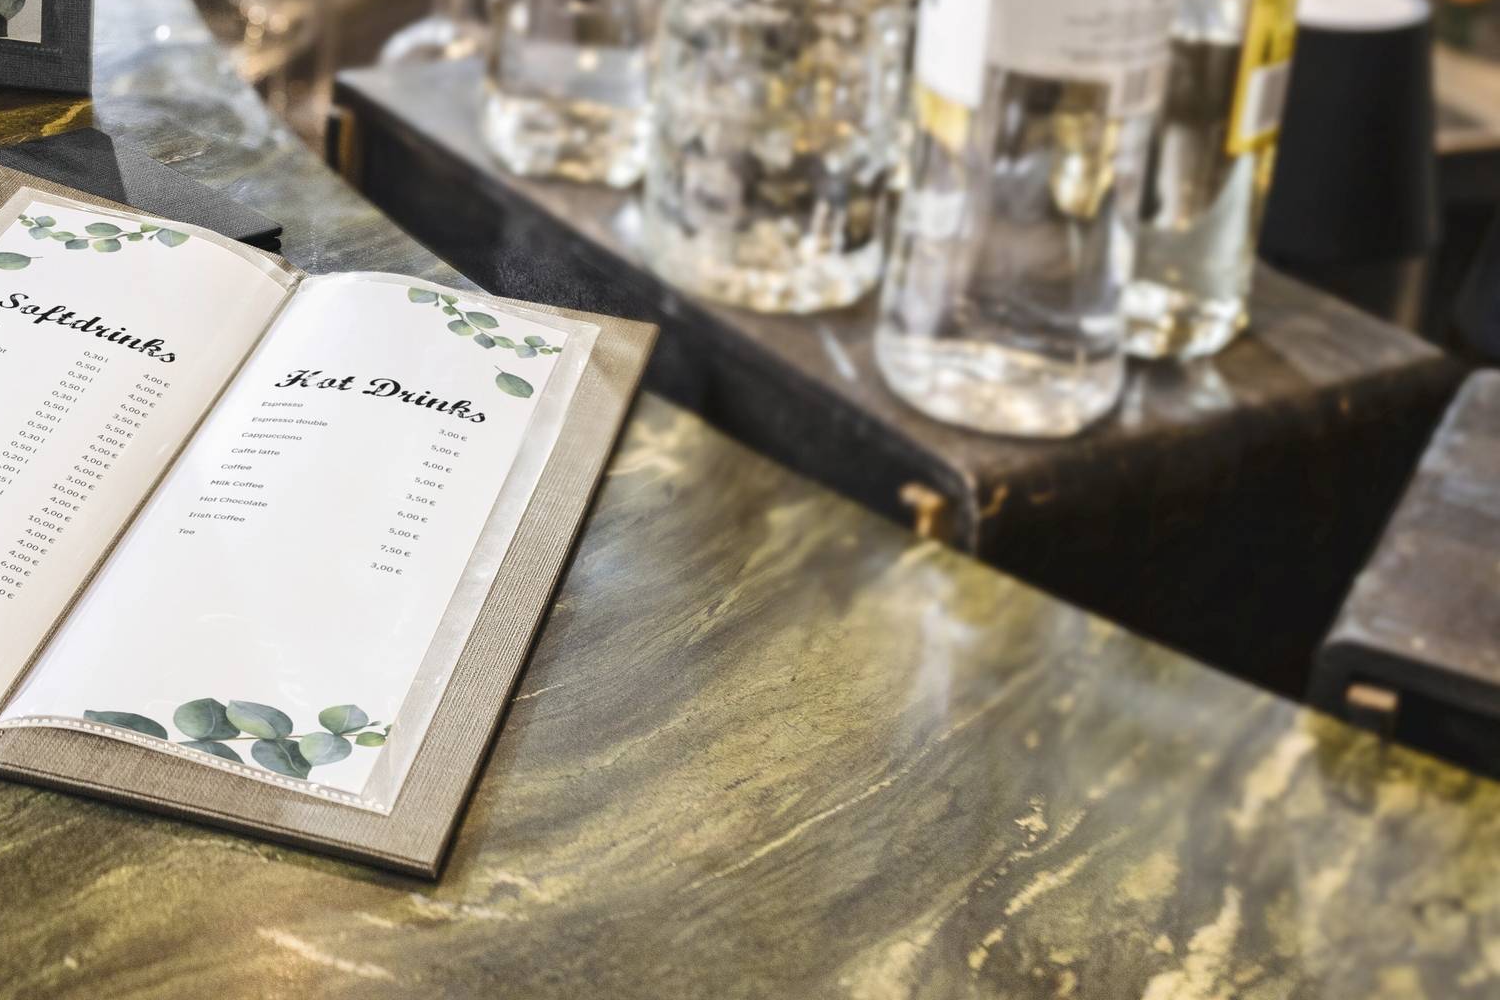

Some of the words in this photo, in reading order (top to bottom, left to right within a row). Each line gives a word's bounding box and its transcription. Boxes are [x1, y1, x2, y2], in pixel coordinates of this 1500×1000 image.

[75, 360, 97, 371] 0,50
[135, 383, 156, 395] 6,00
[83, 351, 104, 362] 0,30
[143, 374, 163, 385] 4,00
[59, 380, 81, 391] 0,50
[120, 403, 141, 415] 6,00
[67, 370, 88, 381] 0,30
[128, 393, 149, 405] 4,00
[274, 369, 356, 391] Hot
[362, 377, 486, 423] Drinks
[43, 400, 65, 411] 0,50
[105, 423, 126, 435] 5,50
[51, 390, 73, 401] 0,30
[112, 413, 134, 425] 3,50
[27, 420, 49, 432] 0,50
[89, 444, 111, 456] 6,00
[35, 410, 57, 421] 0,30
[97, 434, 118, 446] 4,00
[295, 418, 328, 427] double
[430, 444, 452, 455] 5,00
[438, 429, 460, 439] 3,00
[10, 440, 32, 452] 0,50
[73, 465, 95, 477] 6,00
[18, 430, 41, 442] 0,30
[81, 455, 103, 466] 4,00
[2, 450, 24, 462] 0,20
[66, 475, 87, 487] 3,00
[258, 448, 281, 456] latte
[414, 477, 436, 487] 5,00
[422, 461, 444, 471] 4,00
[49, 496, 72, 508] 4,00
[52, 483, 80, 498] 10,00
[232, 480, 264, 489] Coffee
[397, 510, 420, 521] 6,00
[406, 493, 428, 504] 3,50
[28, 514, 56, 530] 10,00
[41, 507, 64, 519] 4,00
[219, 497, 268, 507] Chocolate
[387, 527, 411, 538] 5,00
[17, 539, 39, 552] 4,00
[25, 528, 47, 541] 4,00
[188, 511, 212, 519] Irish
[213, 513, 246, 522] Coffee
[380, 544, 403, 555] 7,50
[0, 560, 23, 573] 6,00
[8, 550, 31, 562] 4,00
[370, 562, 394, 573] 3,00
